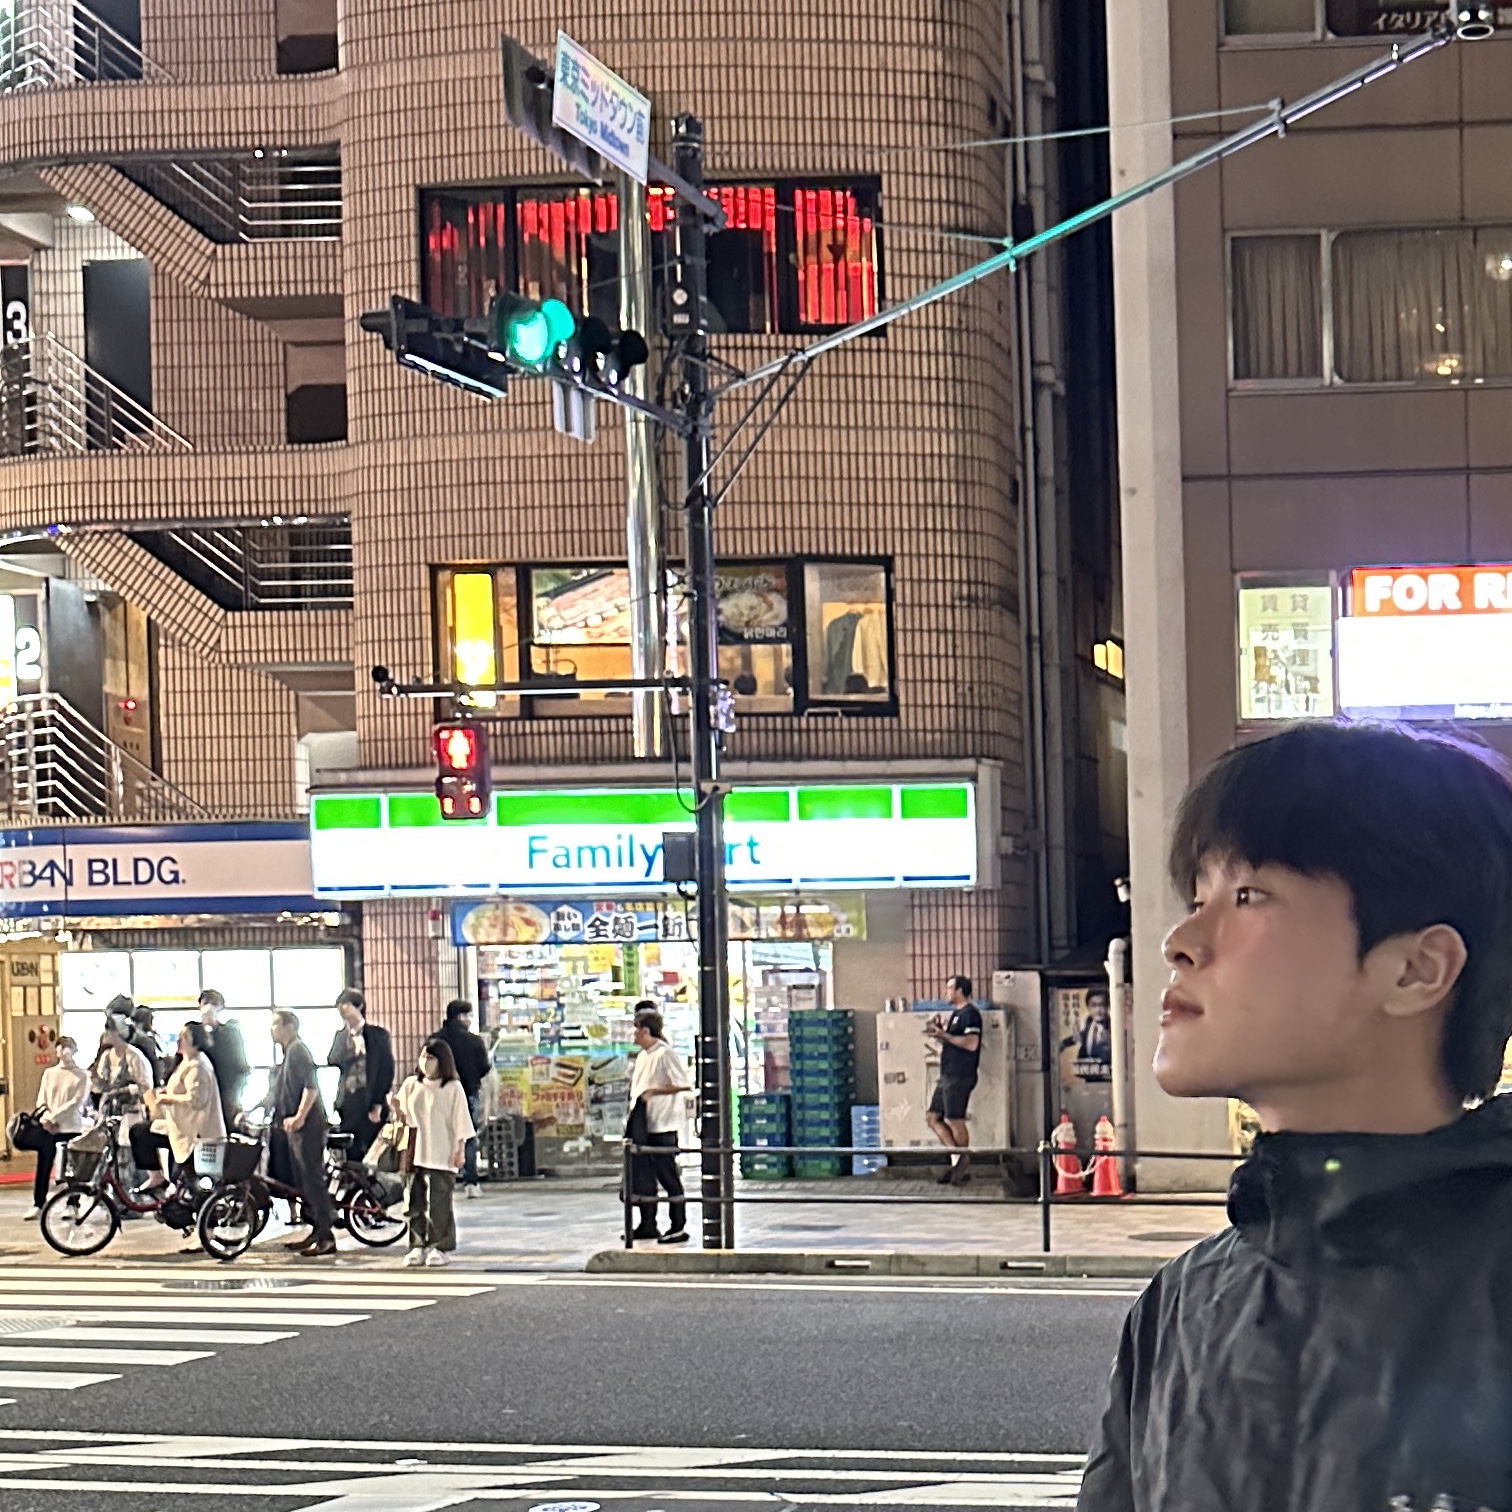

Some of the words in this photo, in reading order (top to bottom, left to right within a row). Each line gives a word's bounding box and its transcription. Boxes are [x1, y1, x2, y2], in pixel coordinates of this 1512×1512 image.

[6, 301, 28, 344] 3
[1364, 573, 1462, 612] FOR
[15, 627, 42, 680] 2
[87, 856, 187, 887] BLDG.
[528, 833, 761, 878] Familyrt
